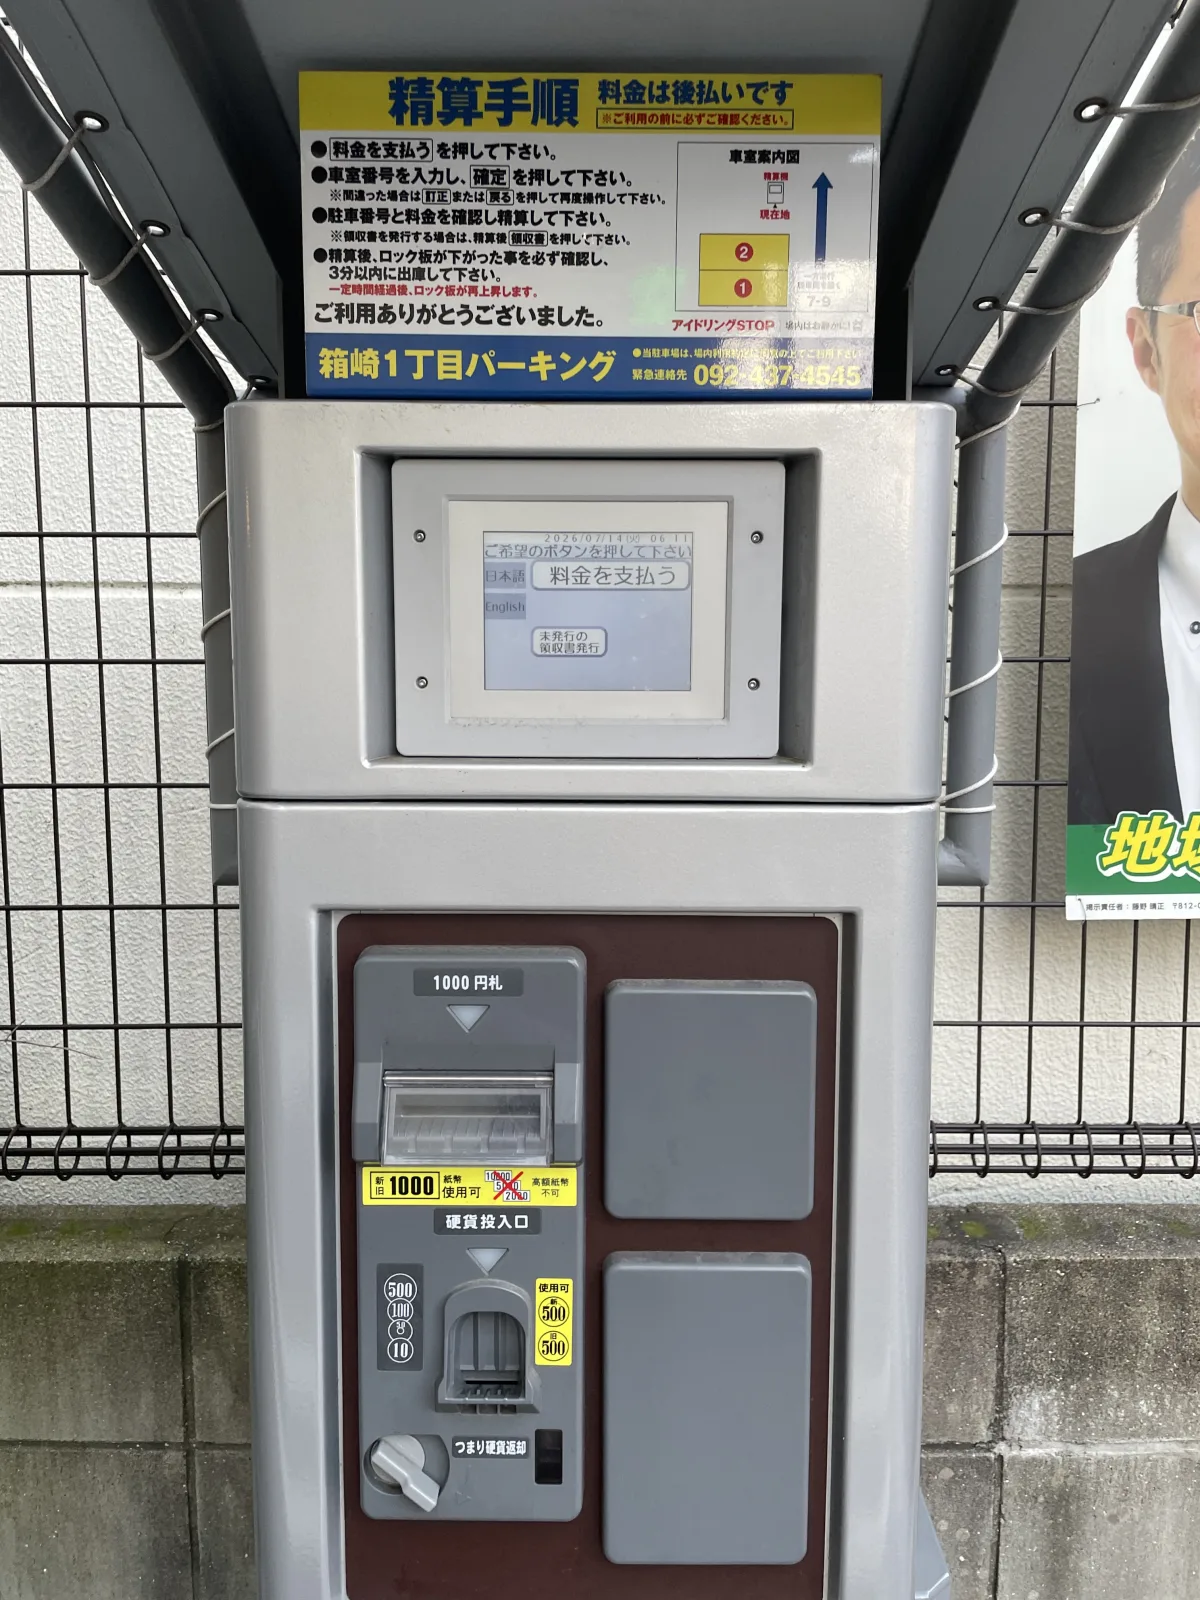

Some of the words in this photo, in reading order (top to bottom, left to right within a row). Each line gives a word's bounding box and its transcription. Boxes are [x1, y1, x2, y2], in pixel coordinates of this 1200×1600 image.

[598, 79, 794, 106] 料金は後払いです
[388, 76, 579, 128] 精算手順
[729, 149, 800, 165] 車室案内図
[763, 172, 789, 182] 精算機
[327, 207, 612, 227] 駐車番号と料金を確認し精算して下さい。
[760, 209, 790, 221] 現在地
[329, 248, 609, 267] 精算後、ロック板が下がった事を必ず確認し、
[739, 246, 749, 259] 2
[329, 266, 501, 283] 3分以内に出庫して下さい。
[329, 284, 538, 298] 一定時間経過後、ロック板が再上昇します。
[314, 302, 604, 328] ご利用ありがとうございました。
[672, 319, 775, 333] アイドリングSTOP
[318, 347, 617, 382] 箱崎1丁目パーキング
[632, 368, 688, 381] 緊急連絡先
[693, 364, 861, 387] 092-437-4545
[485, 544, 692, 559] ご希望のボタンを押して下さい
[486, 569, 525, 583] 日本語
[550, 565, 676, 587] 料金を支払う
[485, 601, 525, 613] English
[540, 631, 588, 642] 未発行の
[540, 643, 600, 654] 領収書発行
[433, 975, 470, 990] 1000
[474, 975, 503, 990] 円札
[390, 1175, 434, 1196] 1000
[443, 1174, 462, 1184] 紙幣
[496, 1181, 519, 1191] 50
[532, 1177, 569, 1187] 高額紙幣
[442, 1186, 481, 1199] 使用可
[505, 1191, 528, 1201] 200
[541, 1188, 559, 1198] 不可
[445, 1214, 529, 1230] 硬貨投入口
[388, 1281, 413, 1298] 500
[538, 1283, 569, 1294] 使用可
[392, 1302, 410, 1318] 100
[542, 1305, 566, 1322] 500
[393, 1342, 409, 1359] 10
[541, 1340, 565, 1356] 500
[455, 1440, 526, 1456] つまり硬貨返却
